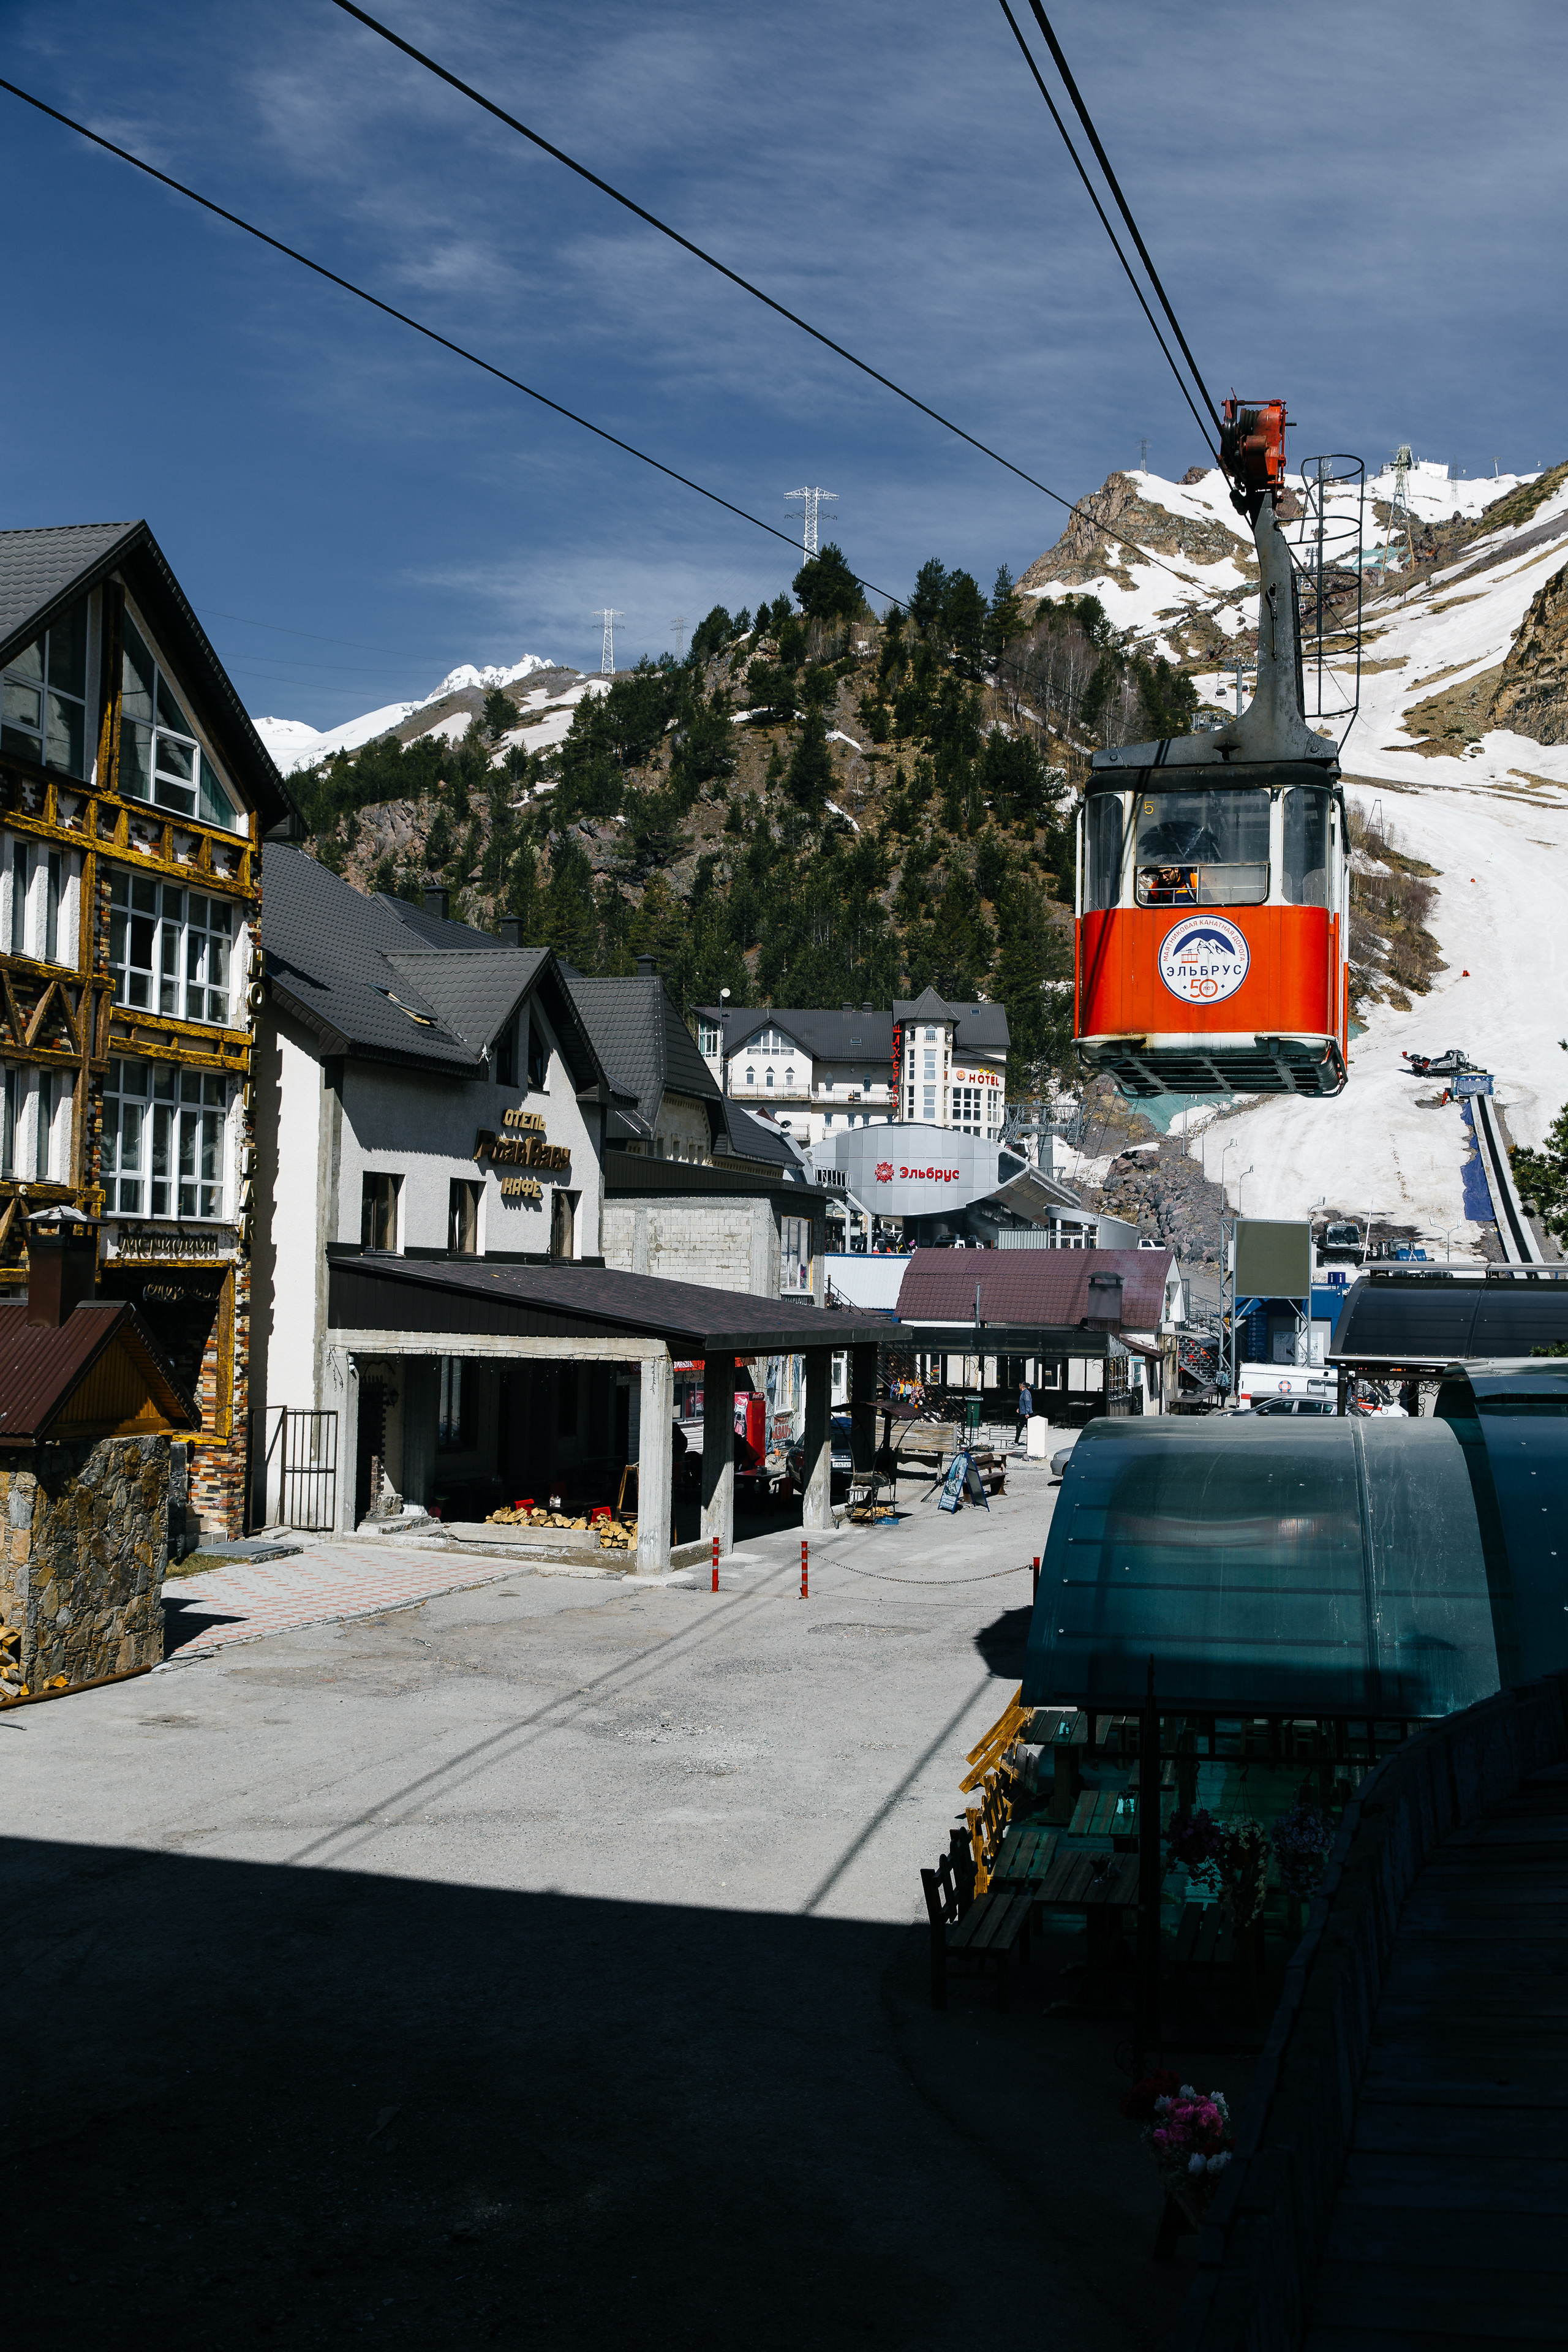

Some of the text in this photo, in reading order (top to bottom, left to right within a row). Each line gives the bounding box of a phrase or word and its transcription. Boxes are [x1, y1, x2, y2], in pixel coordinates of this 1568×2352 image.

[1144, 801, 1154, 815] 5
[1163, 919, 1245, 962] МАЯТНИКОВАЯ КАНАТНАЯ ДОРОГА
[1166, 965, 1242, 977] ЭЛЬБРУС
[1190, 979, 1218, 998] 50
[244, 948, 266, 1110] HOTEL
[969, 1074, 1000, 1087] HOTEL
[503, 1109, 546, 1131] ОТЕЛЬ
[899, 1166, 960, 1182] Эльбрус
[239, 1147, 260, 1241] BAR
[501, 1177, 543, 1198] КАФЕ
